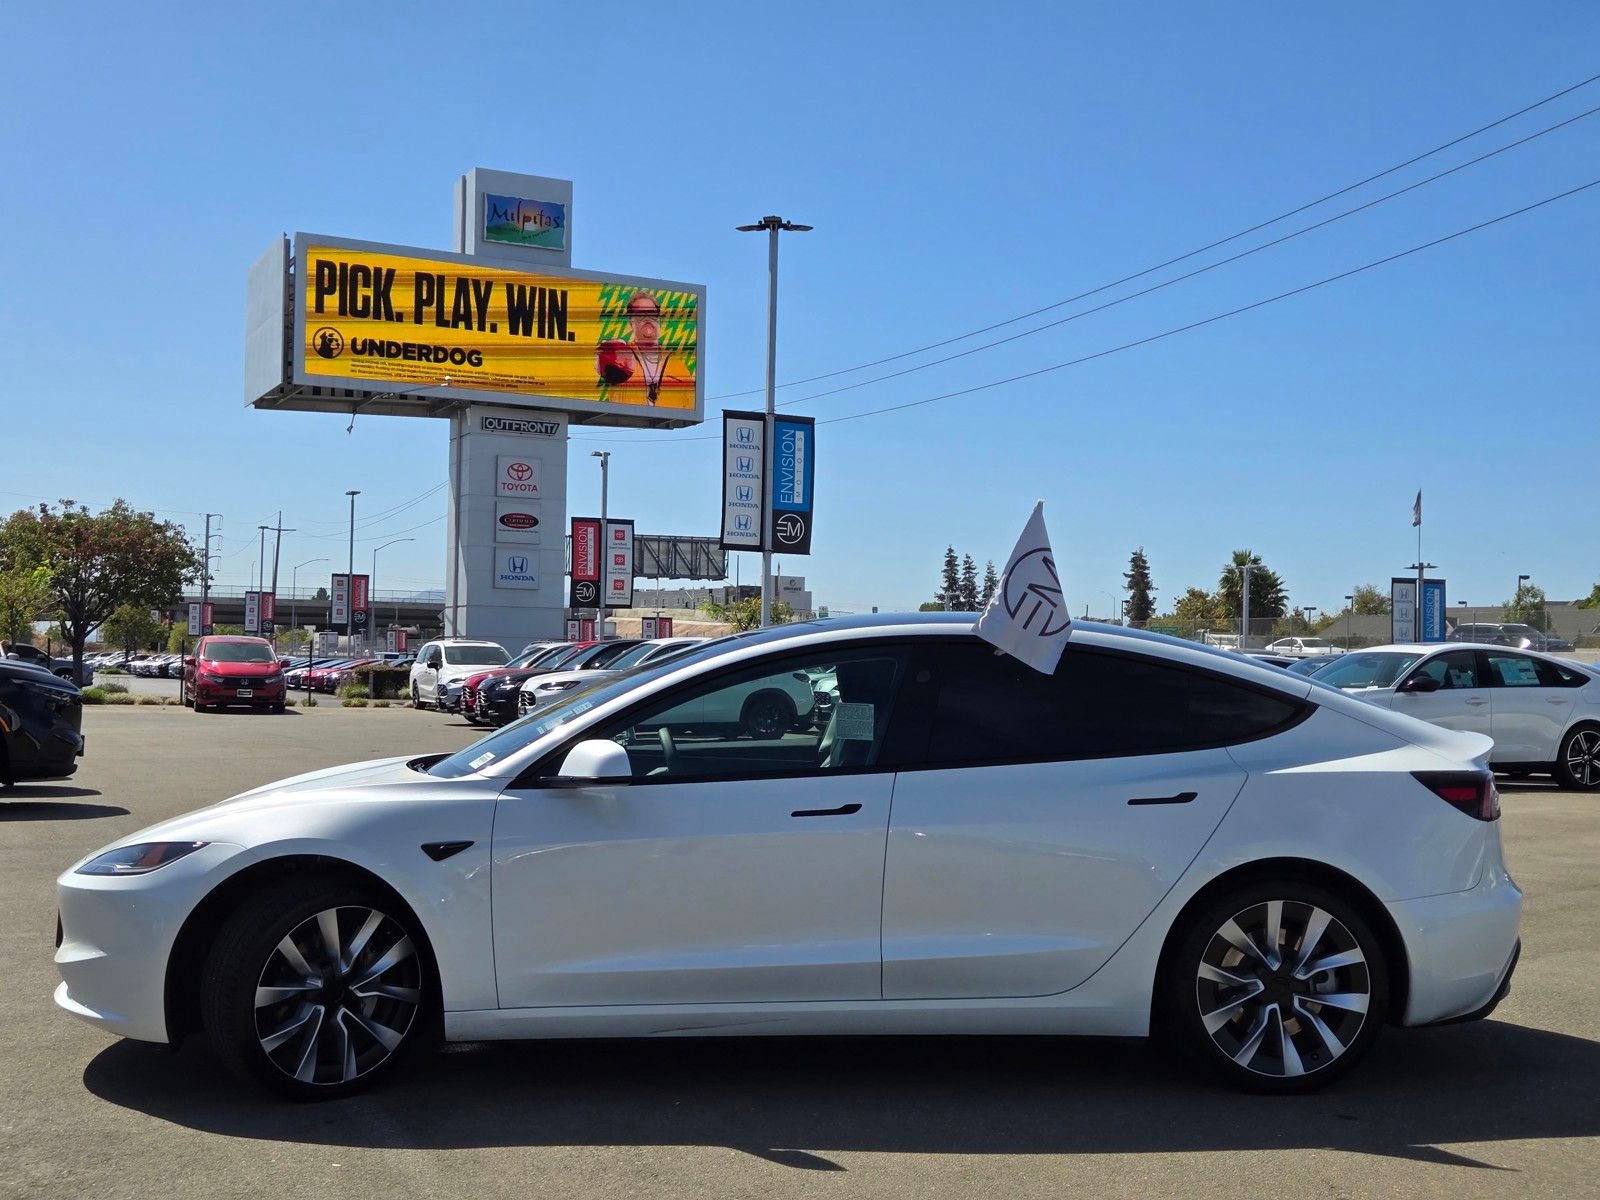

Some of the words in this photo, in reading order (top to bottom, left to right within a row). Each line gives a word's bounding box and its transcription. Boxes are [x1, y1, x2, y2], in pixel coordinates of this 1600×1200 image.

[489, 200, 560, 233] Milpitas
[314, 259, 404, 323] PICK.
[414, 271, 498, 334] PLAY.
[505, 282, 576, 342] WIN.
[350, 336, 483, 367] UNDERDOG
[729, 472, 760, 480] HONDA
[780, 428, 795, 503] ENVISION
[501, 482, 538, 492] TOYOTA
[728, 501, 759, 509] HONDA
[726, 530, 758, 538] HONDA
[578, 526, 588, 576] ENVISION
[1425, 587, 1434, 638] ENVISION
